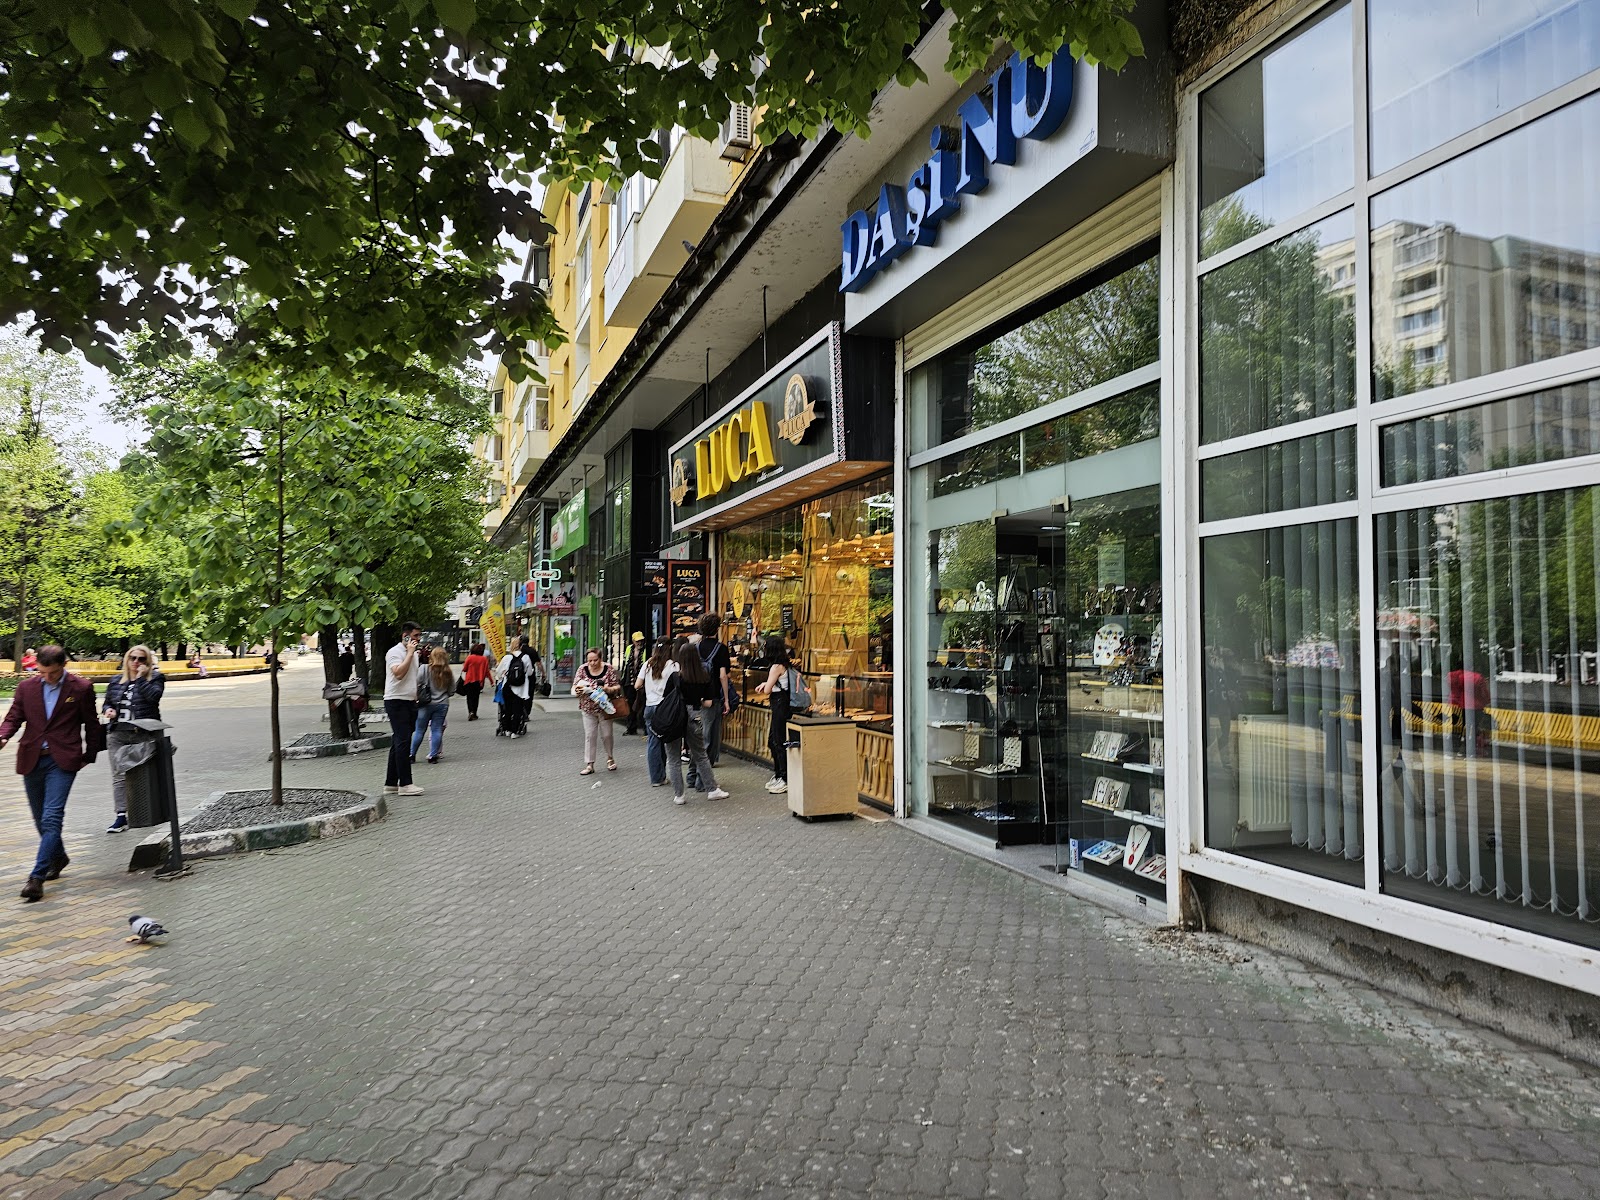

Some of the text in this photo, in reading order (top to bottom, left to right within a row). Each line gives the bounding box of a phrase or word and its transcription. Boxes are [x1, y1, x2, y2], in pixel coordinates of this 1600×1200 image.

[787, 415, 806, 435] LUCA
[694, 401, 776, 501] LUCA
[676, 569, 701, 578] LUCA
